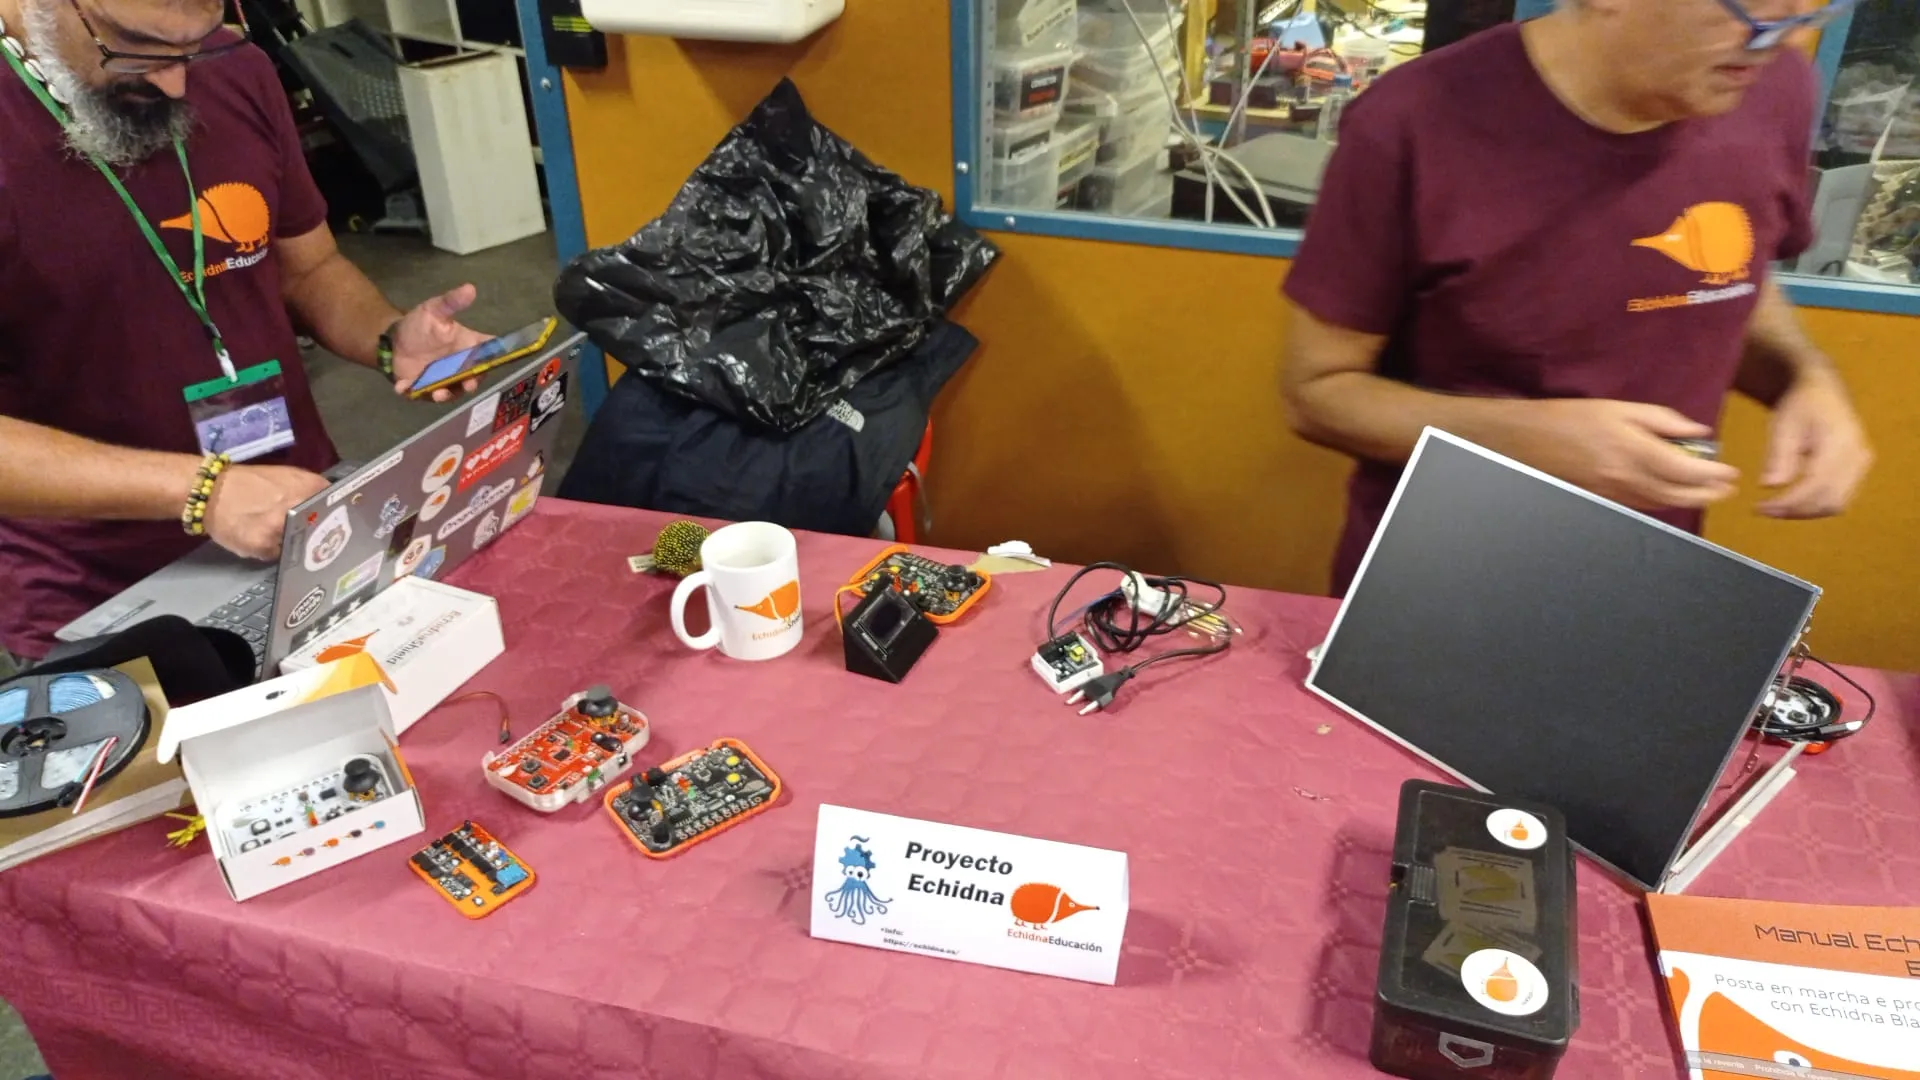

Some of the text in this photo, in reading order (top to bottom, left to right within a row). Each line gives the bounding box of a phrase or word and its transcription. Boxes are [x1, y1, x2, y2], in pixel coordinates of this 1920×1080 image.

[904, 841, 1013, 875] Proyecto
[907, 873, 1005, 906] Echidna
[1007, 928, 1103, 953] EchidnaEducación
[1754, 924, 1920, 954] Manual Ech
[1714, 974, 1765, 992] Posta
[1771, 984, 1793, 995] en
[1799, 986, 1870, 1005] marcha
[1877, 996, 1887, 1007] e
[1771, 1000, 1920, 1029] con Echidna Bla
